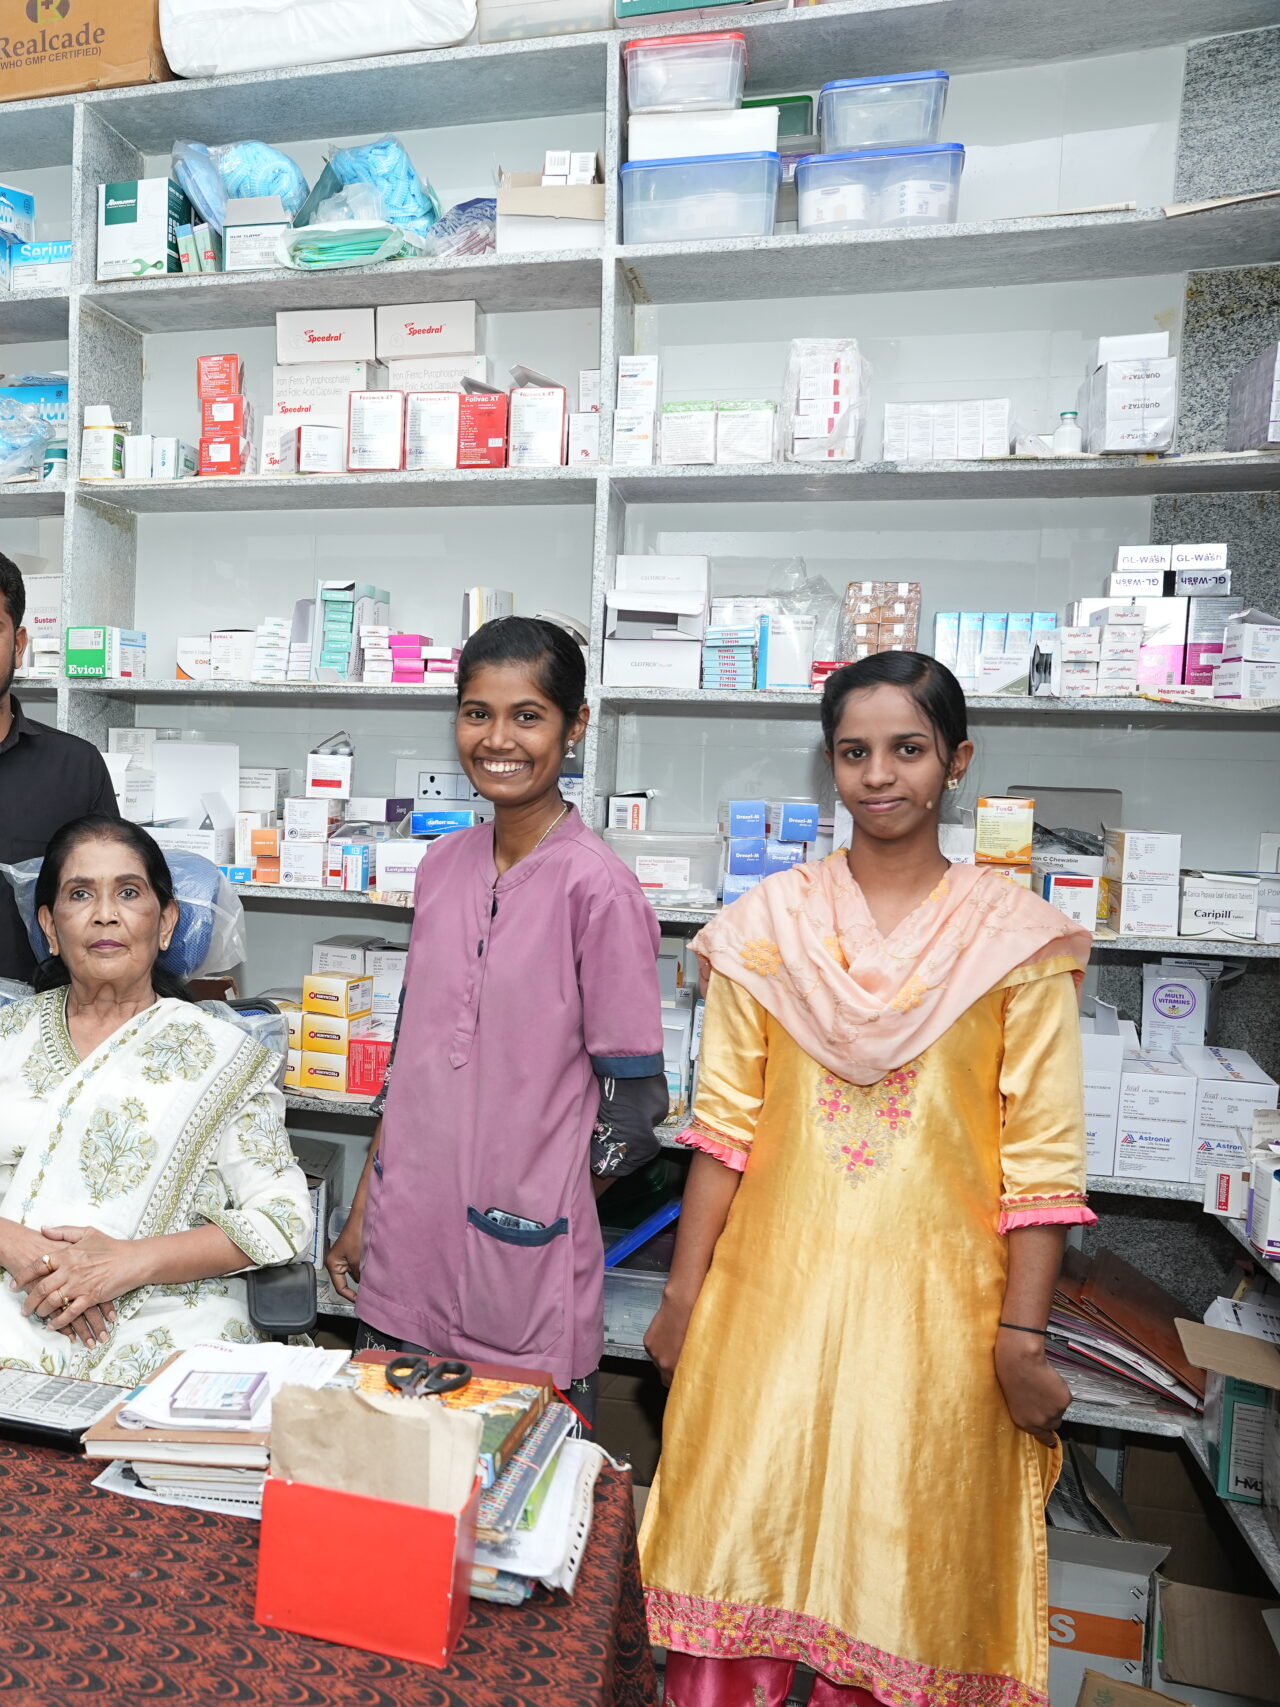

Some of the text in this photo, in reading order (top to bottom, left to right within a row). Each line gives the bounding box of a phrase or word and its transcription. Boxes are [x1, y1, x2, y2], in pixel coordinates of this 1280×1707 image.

[25, 56, 46, 66] GMP
[48, 47, 102, 63] CERTIFIED)
[21, 244, 71, 263] Serjun
[407, 324, 443, 336] Speedral
[307, 332, 342, 343] Speedral
[280, 404, 312, 415] Speedral
[1123, 556, 1165, 564] GL-Wash
[1177, 554, 1221, 562] GL-Wash
[1116, 578, 1159, 586] GL-Wash
[1181, 576, 1226, 584] GL-Wash
[68, 665, 103, 674] Evion
[1194, 909, 1231, 920] Caripill
[1158, 998, 1190, 1006] VITAMINS
[1139, 1135, 1171, 1143] Astronia
